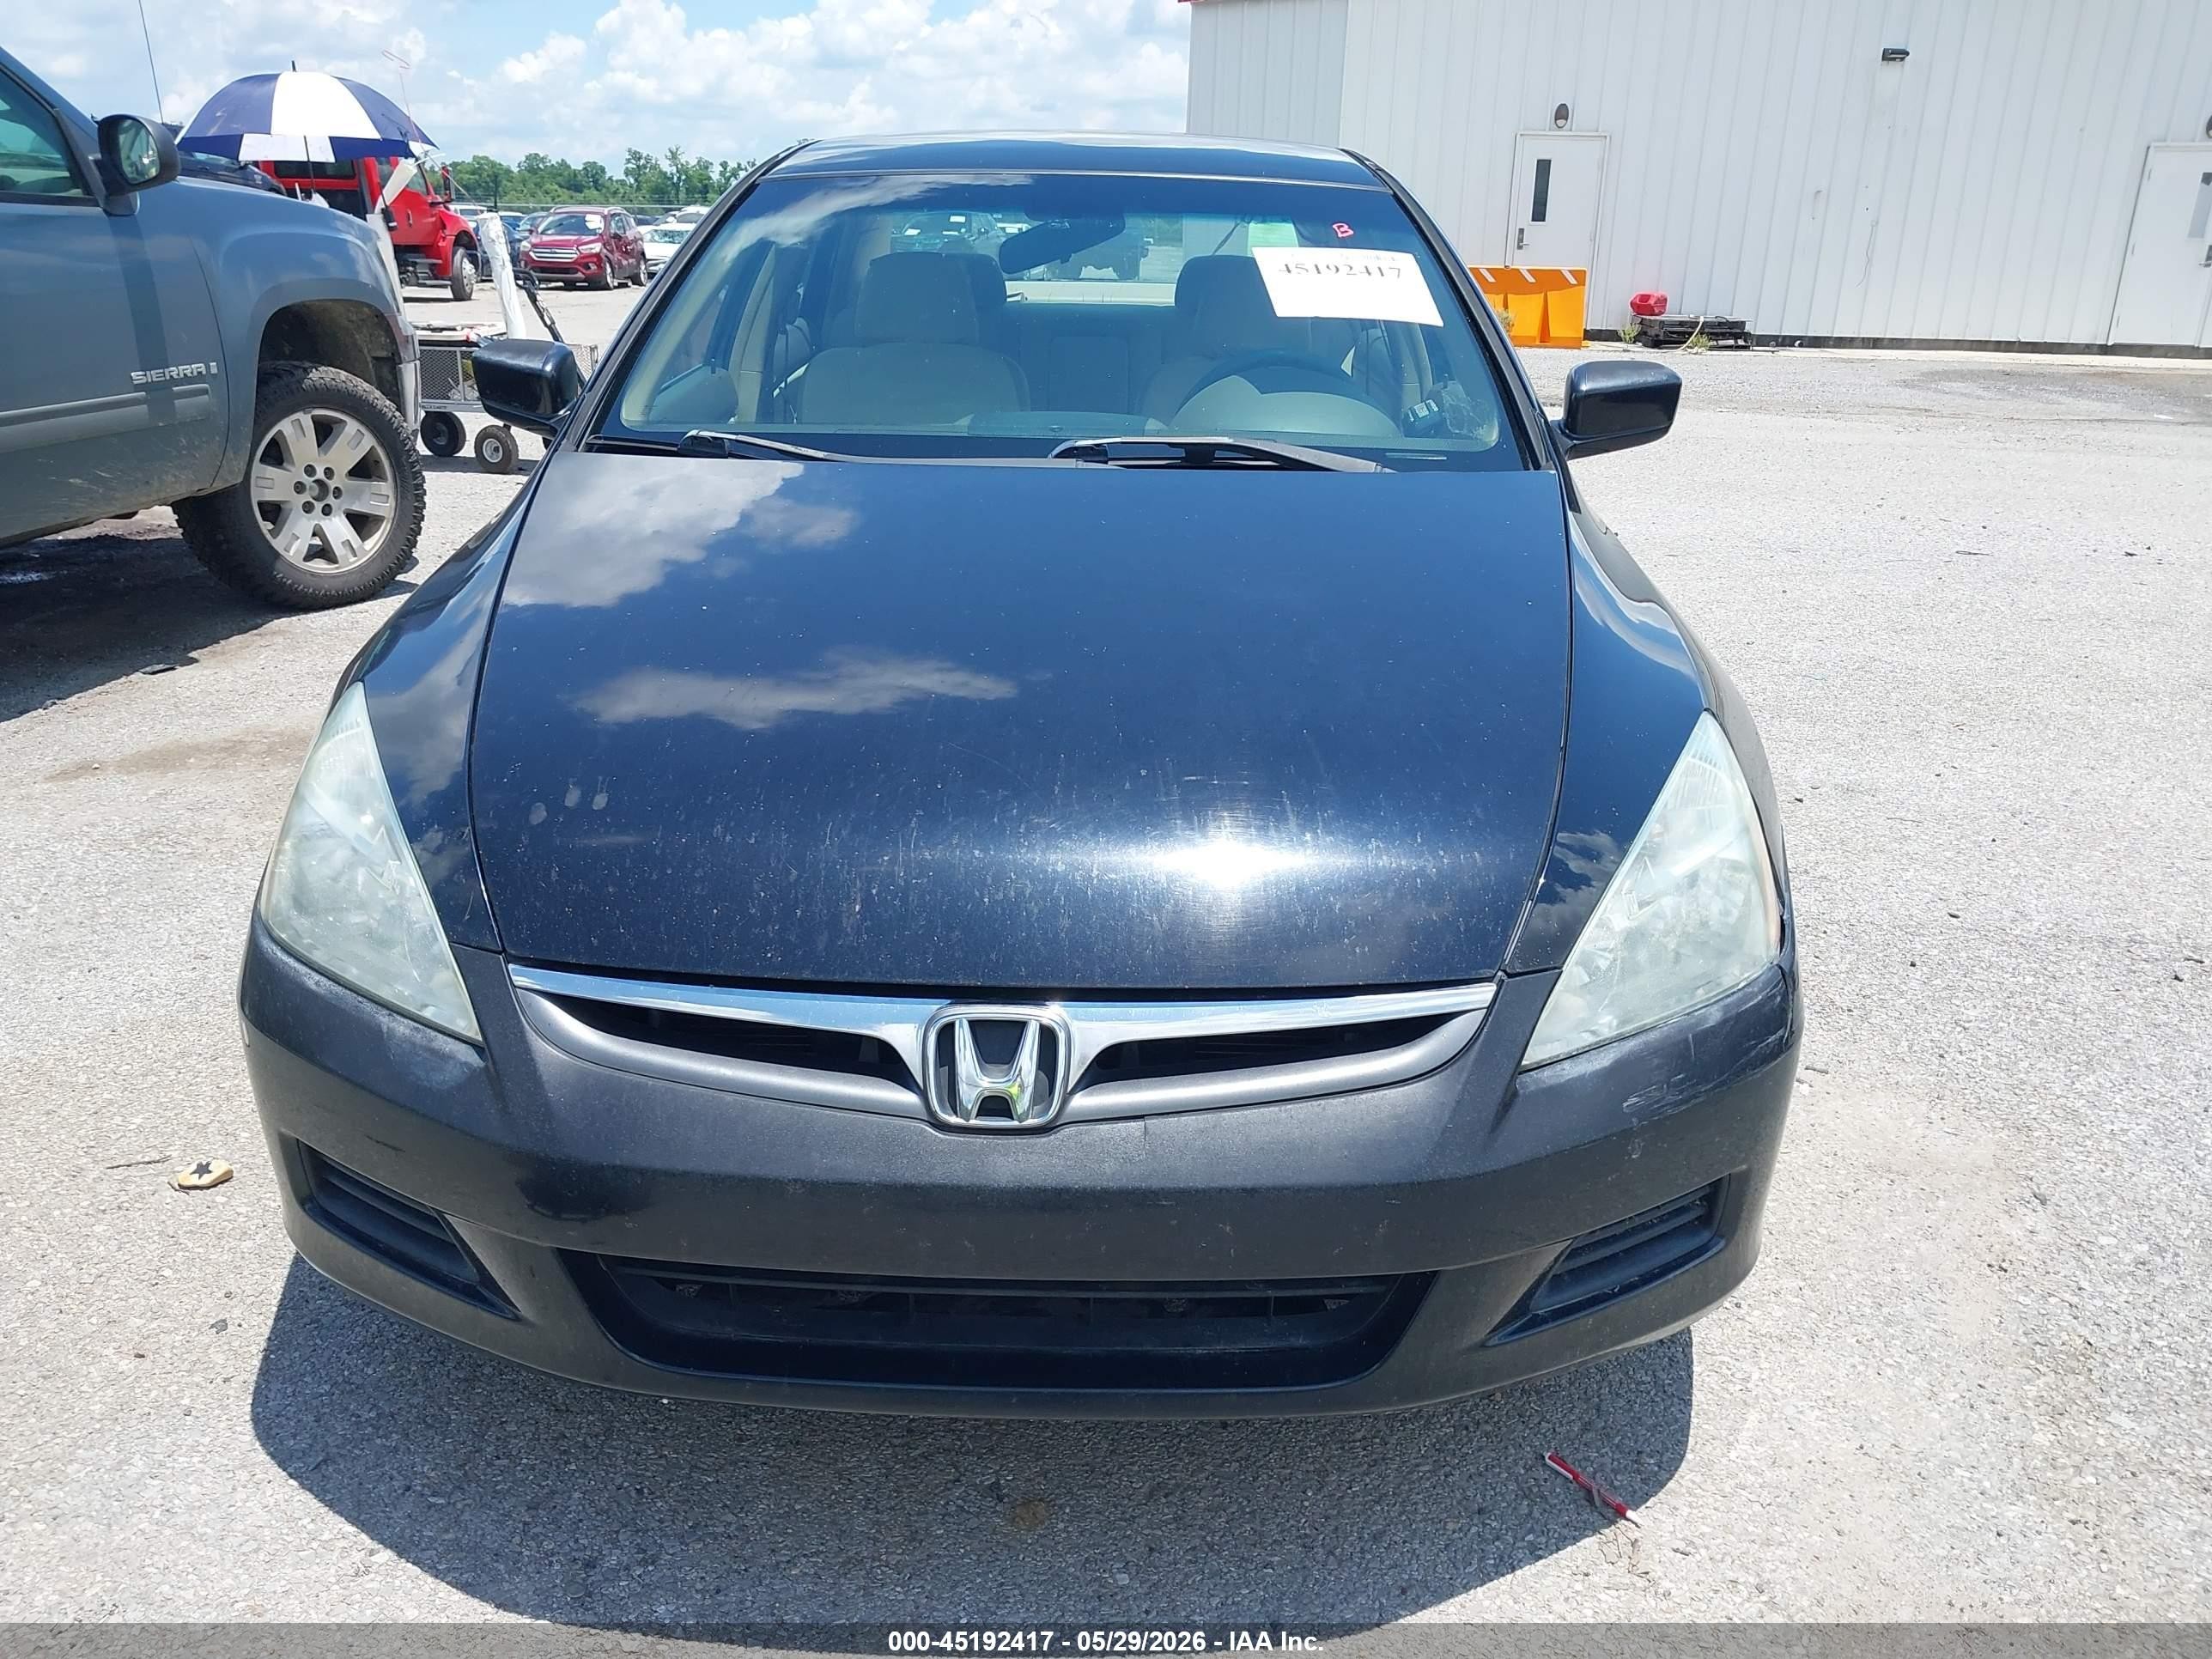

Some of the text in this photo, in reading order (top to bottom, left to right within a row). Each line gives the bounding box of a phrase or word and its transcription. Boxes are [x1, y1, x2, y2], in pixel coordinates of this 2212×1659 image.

[1332, 222, 1354, 238] B
[1279, 262, 1401, 279] 45192417
[131, 363, 207, 385] SIERRA
